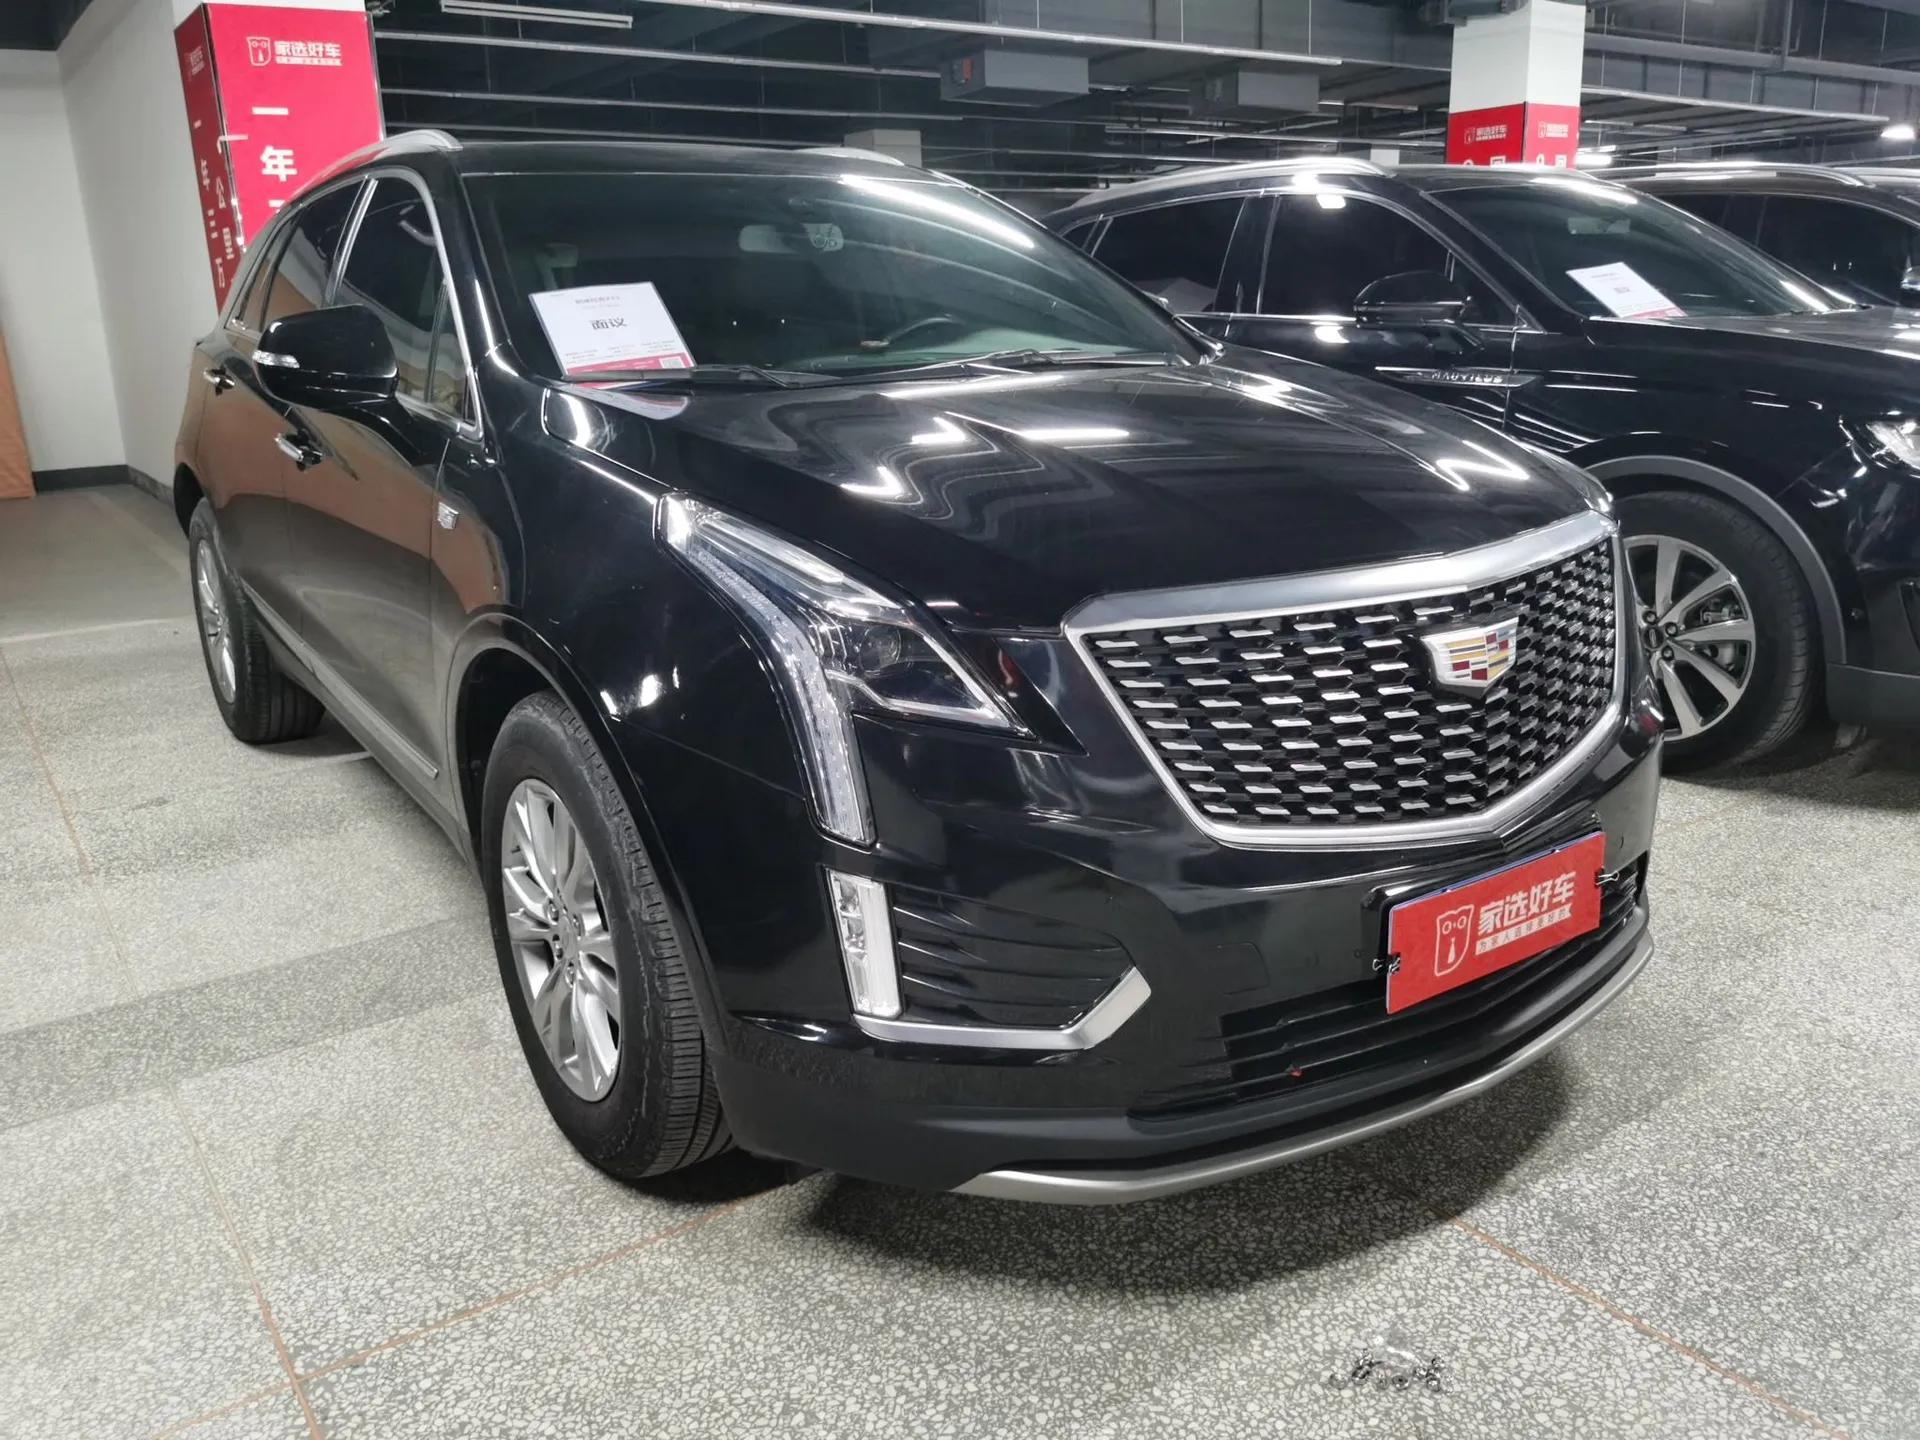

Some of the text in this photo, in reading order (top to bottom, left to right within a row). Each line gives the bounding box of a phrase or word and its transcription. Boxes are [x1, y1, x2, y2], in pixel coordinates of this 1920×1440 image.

[274, 40, 342, 57] 家选好车
[1478, 871, 1576, 936] 家选好车
